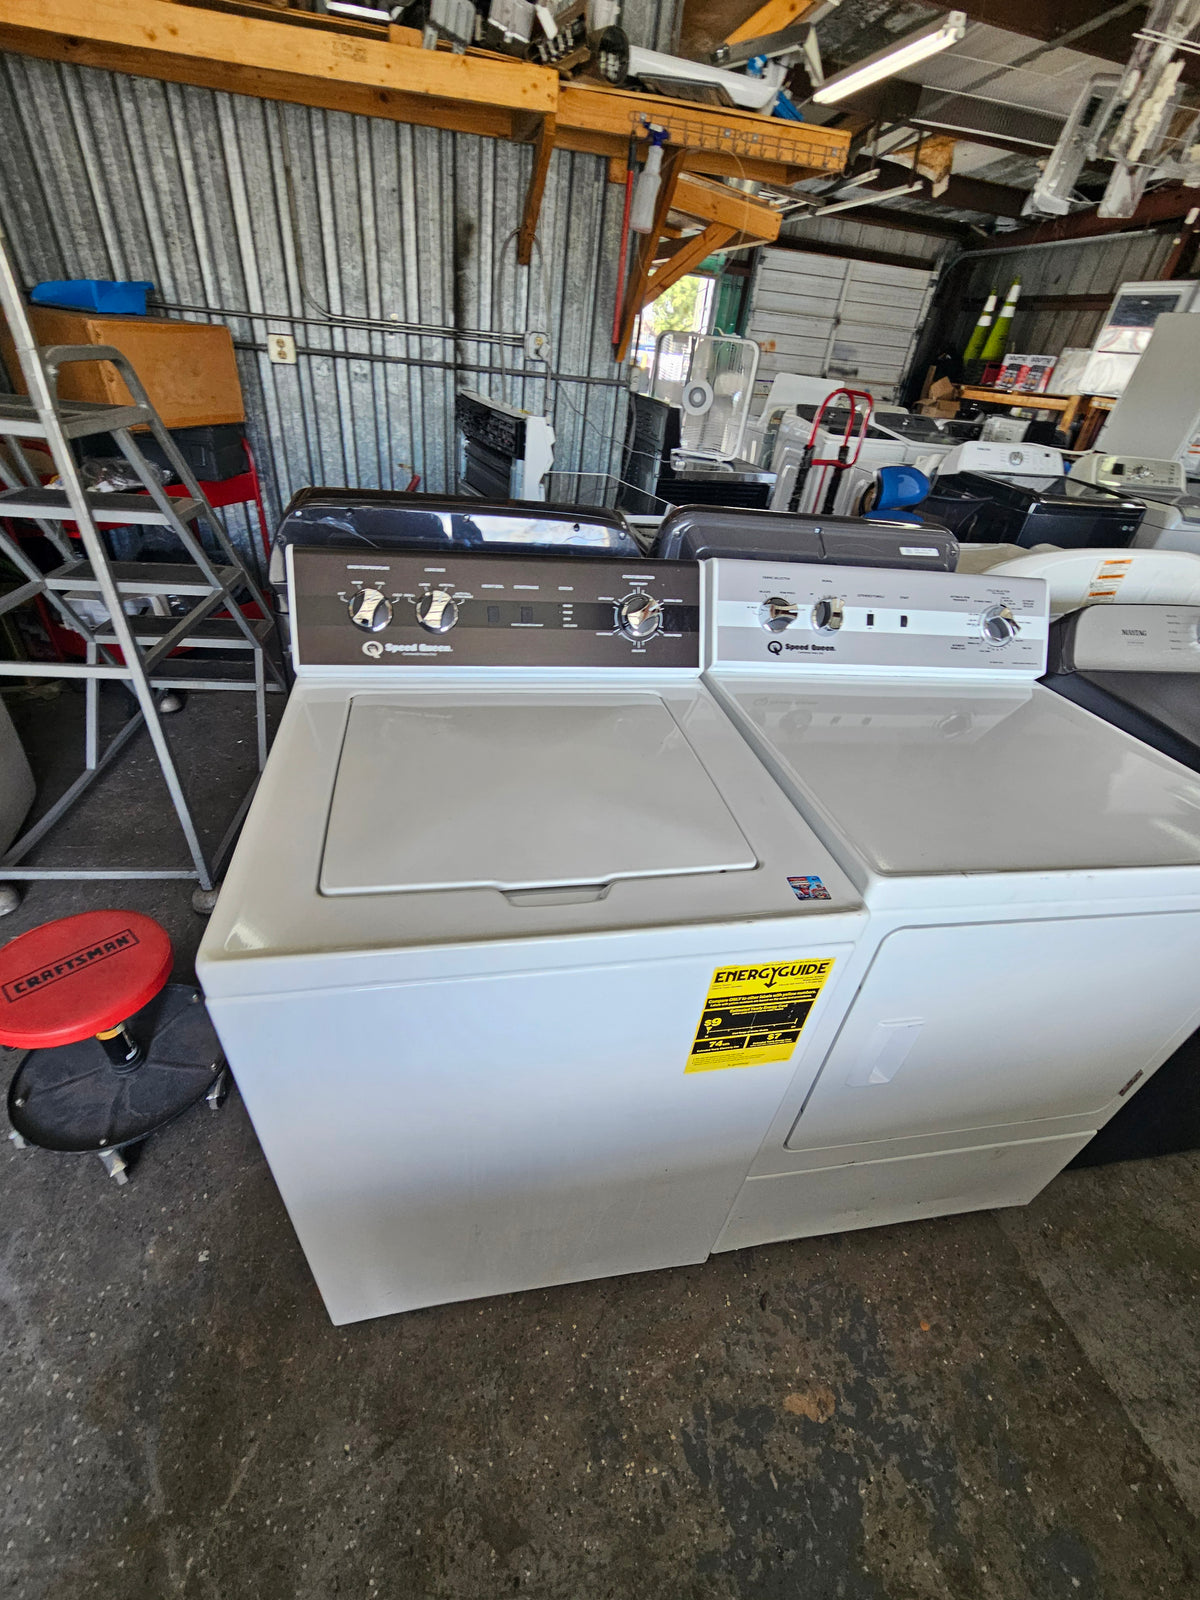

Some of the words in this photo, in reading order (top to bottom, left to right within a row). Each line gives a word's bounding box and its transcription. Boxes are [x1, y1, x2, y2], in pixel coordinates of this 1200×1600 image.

[385, 643, 418, 653] Speed
[785, 643, 809, 651] Speed
[13, 935, 131, 994] CRAFTSMAN
[714, 962, 830, 985] ENERGYGUIDE
